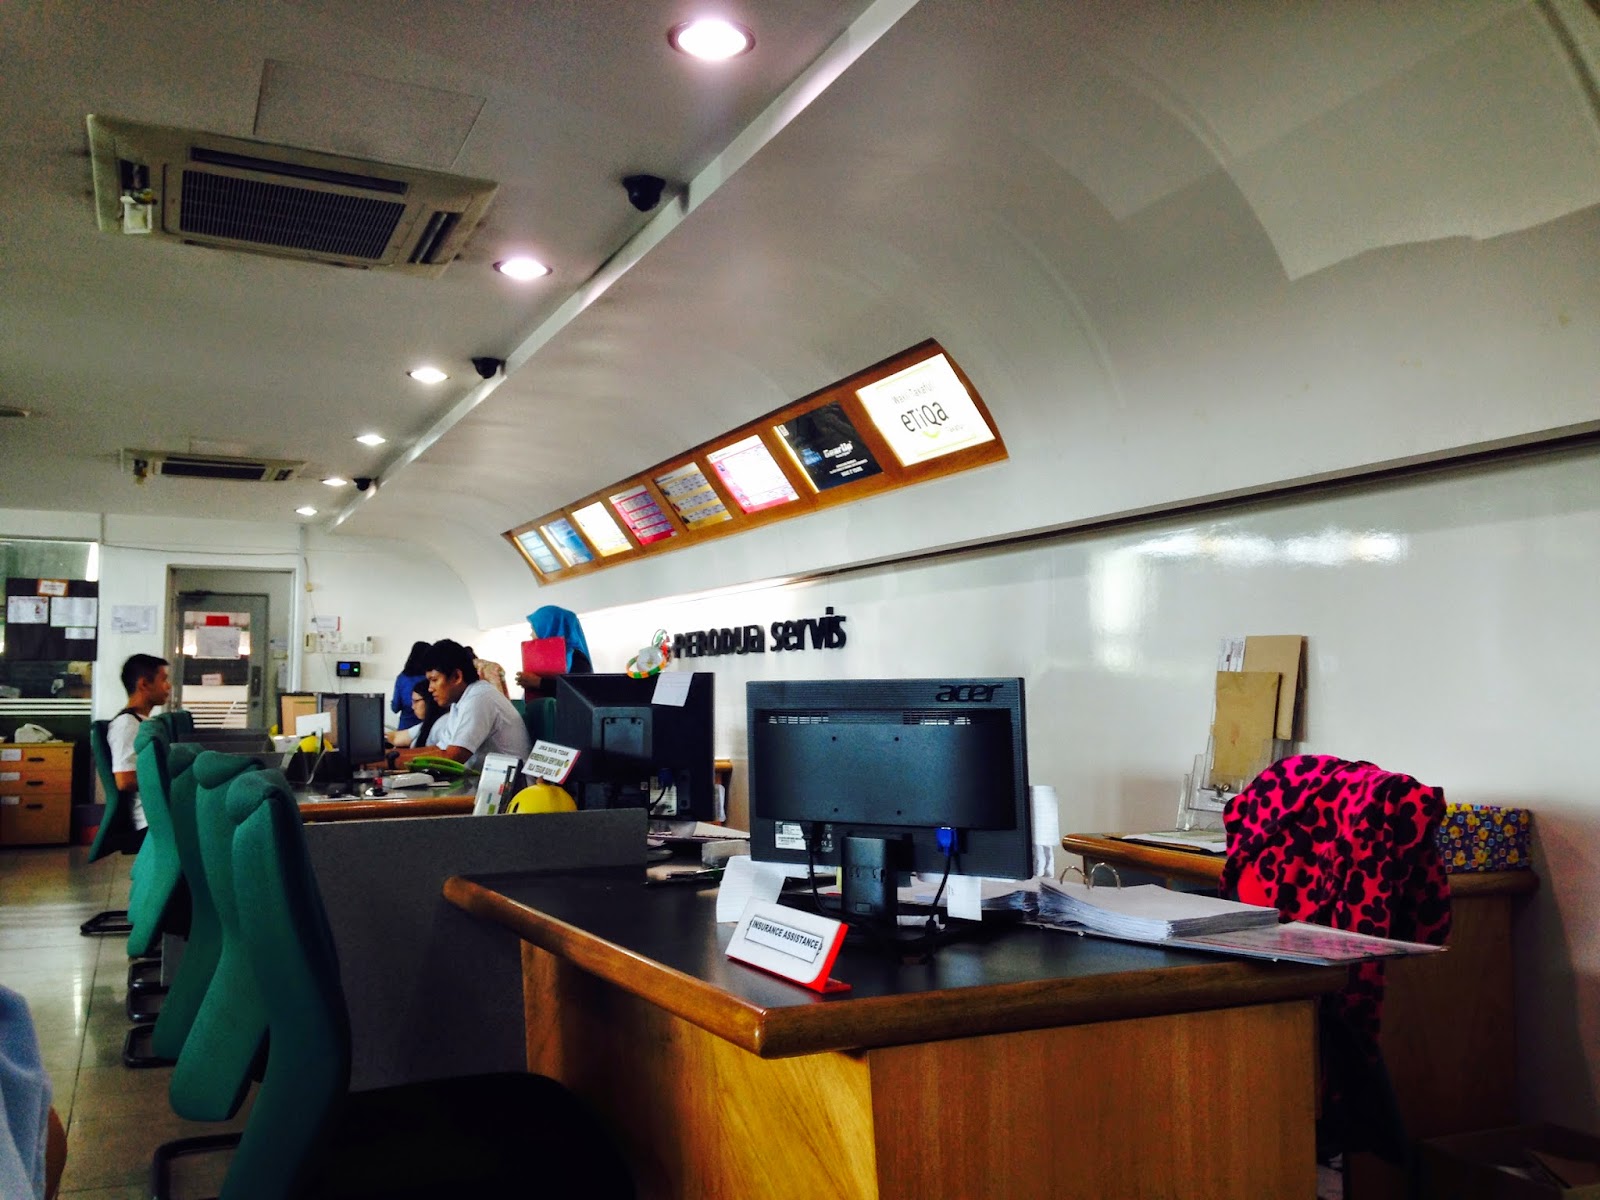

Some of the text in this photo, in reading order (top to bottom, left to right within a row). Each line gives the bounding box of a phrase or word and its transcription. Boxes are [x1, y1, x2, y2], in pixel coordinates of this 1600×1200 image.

[770, 606, 847, 652] servis
[935, 684, 1003, 703] acer
[752, 920, 820, 949] INSURANCE ASSISTANCE
